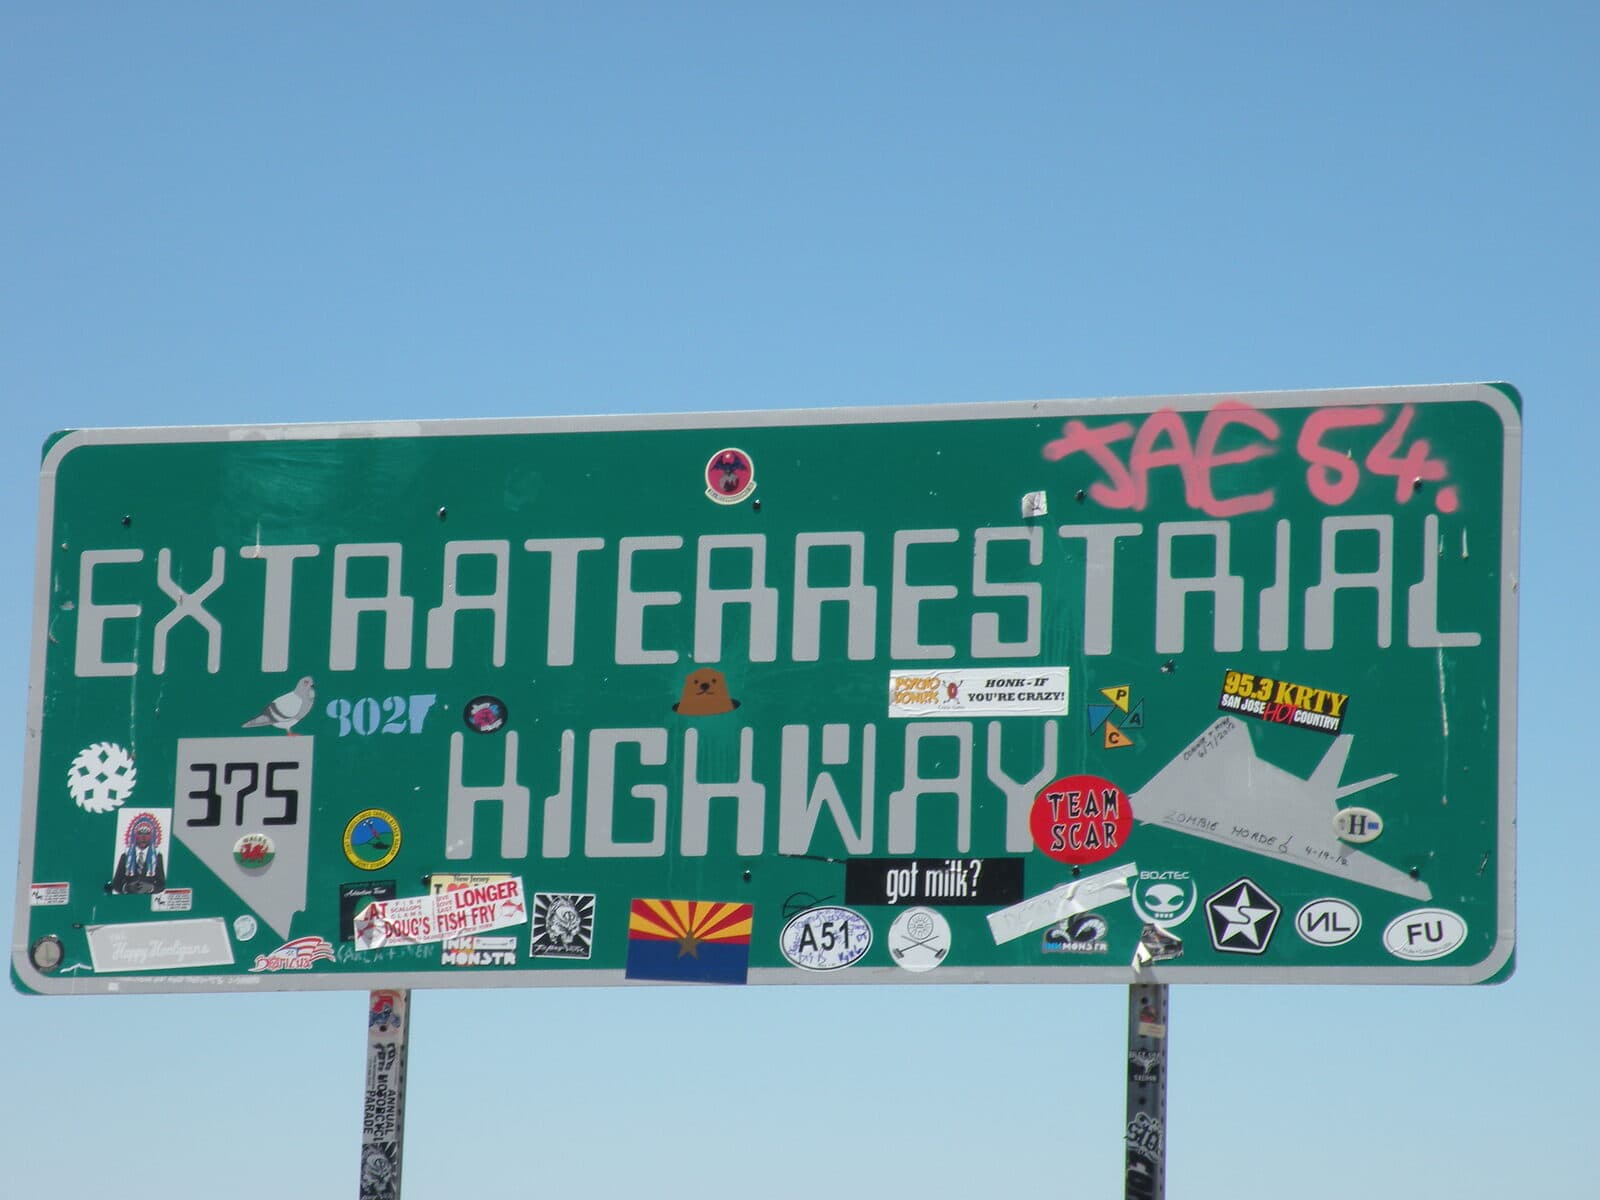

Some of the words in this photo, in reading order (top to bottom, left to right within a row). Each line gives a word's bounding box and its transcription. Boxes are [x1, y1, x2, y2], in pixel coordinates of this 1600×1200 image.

[74, 514, 1482, 678] EXTRATERRESTRIAL
[967, 691, 1016, 703] YOU'RE
[1017, 691, 1066, 702] CRAZY!
[985, 678, 1024, 688] HONK
[1115, 689, 1127, 701] P
[1223, 671, 1274, 702] 95.3
[1273, 681, 1349, 717] KRTY
[1221, 693, 1242, 709] SAN
[1240, 698, 1267, 714] JOSE
[1263, 702, 1298, 724] HOT
[1293, 709, 1341, 730] COUNTRY!
[1108, 732, 1121, 745] C
[186, 761, 300, 827] 375
[445, 719, 1059, 860] HIGHWAY
[1047, 788, 1119, 822] TEAM
[1050, 820, 1118, 852] SCAR
[1165, 811, 1220, 832] ZOMBIE
[1348, 814, 1368, 836] H
[454, 880, 519, 909] LONGER
[886, 861, 919, 905] got
[925, 858, 982, 897] milk?
[384, 916, 431, 939] DOUG'S
[437, 909, 468, 933] FISH
[471, 903, 497, 926] FRY
[798, 919, 850, 953] A51
[1406, 920, 1444, 946] FU
[363, 1089, 377, 1135] PARADE
[372, 1073, 389, 1142] MOTORCYCL
[384, 1089, 397, 1136] ANNUAL
